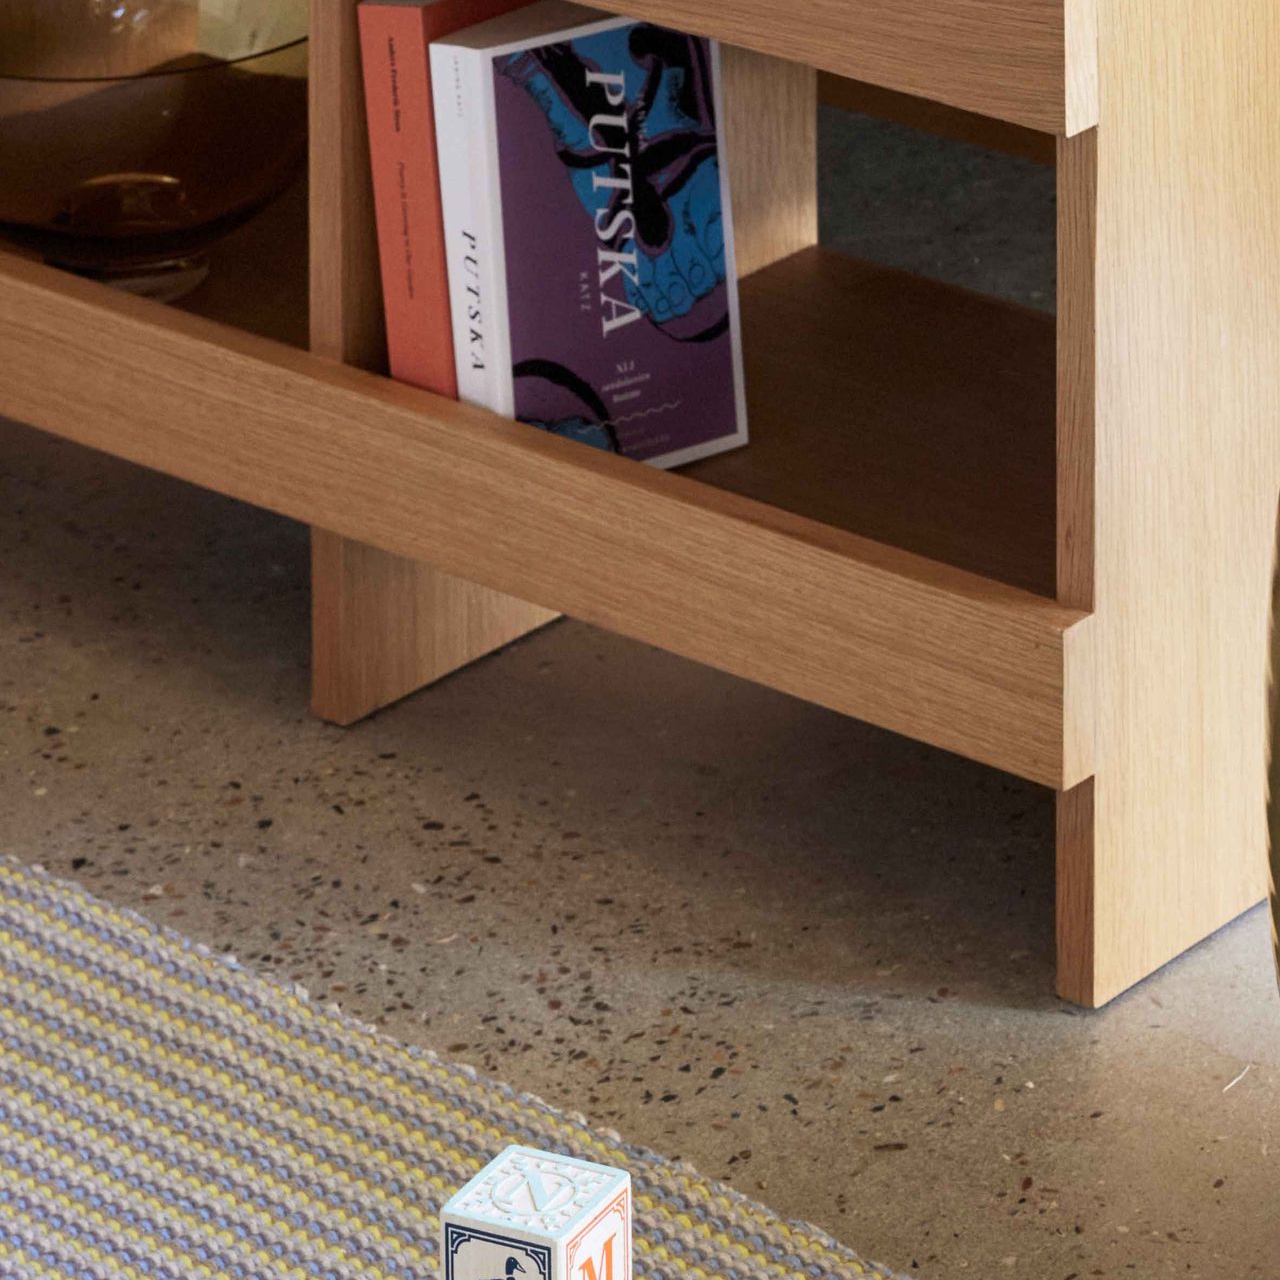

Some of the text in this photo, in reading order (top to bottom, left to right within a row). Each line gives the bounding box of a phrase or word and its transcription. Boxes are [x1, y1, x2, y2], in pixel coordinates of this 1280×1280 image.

[586, 69, 643, 339] PUTSKA
[462, 230, 485, 371] PUTSKA
[579, 271, 592, 311] KATZ
